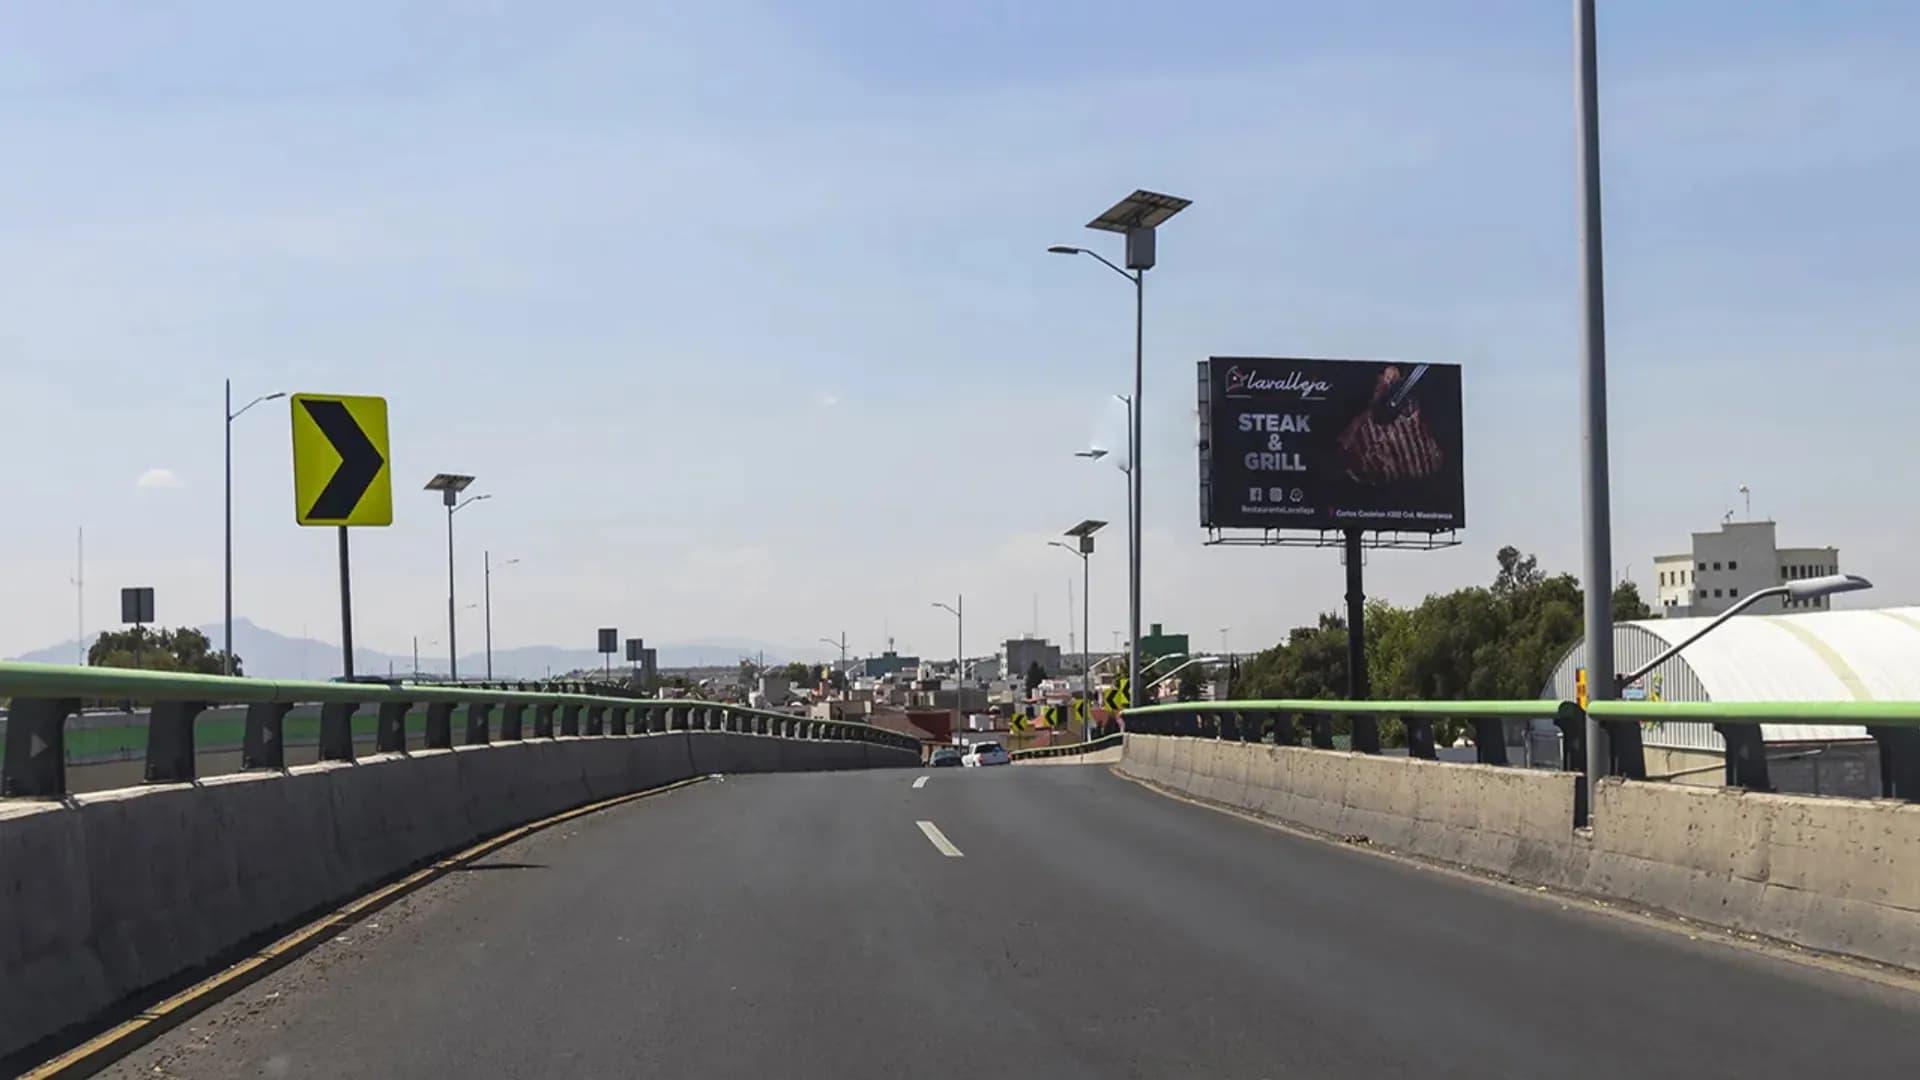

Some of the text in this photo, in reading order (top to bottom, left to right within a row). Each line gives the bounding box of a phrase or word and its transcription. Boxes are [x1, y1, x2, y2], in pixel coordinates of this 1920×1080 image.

[1238, 413, 1311, 433] STEAK
[1267, 433, 1283, 451] &
[1244, 452, 1307, 472] GRILL
